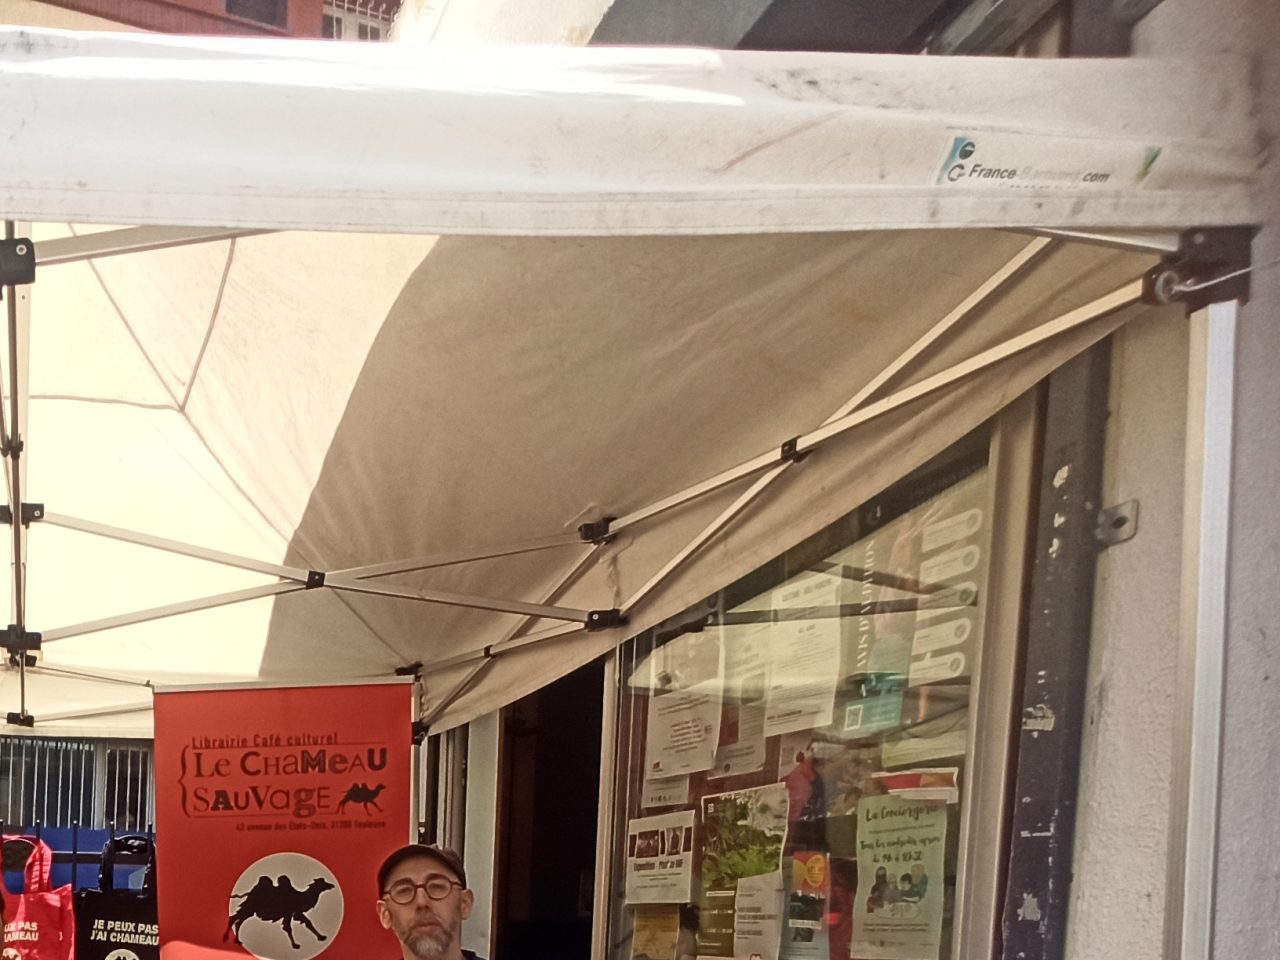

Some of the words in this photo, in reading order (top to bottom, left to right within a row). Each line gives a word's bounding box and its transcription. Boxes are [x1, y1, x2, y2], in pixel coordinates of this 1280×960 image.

[192, 735, 248, 750] Librairie
[253, 733, 282, 748] Café
[287, 732, 338, 746] culturel
[195, 753, 231, 778] Le
[18, 921, 38, 931] PAS
[93, 919, 105, 930] JE
[107, 920, 135, 931] PEUX
[137, 923, 159, 935] PAS
[90, 930, 107, 941] J'AI
[110, 931, 160, 946] CHAMEAU
